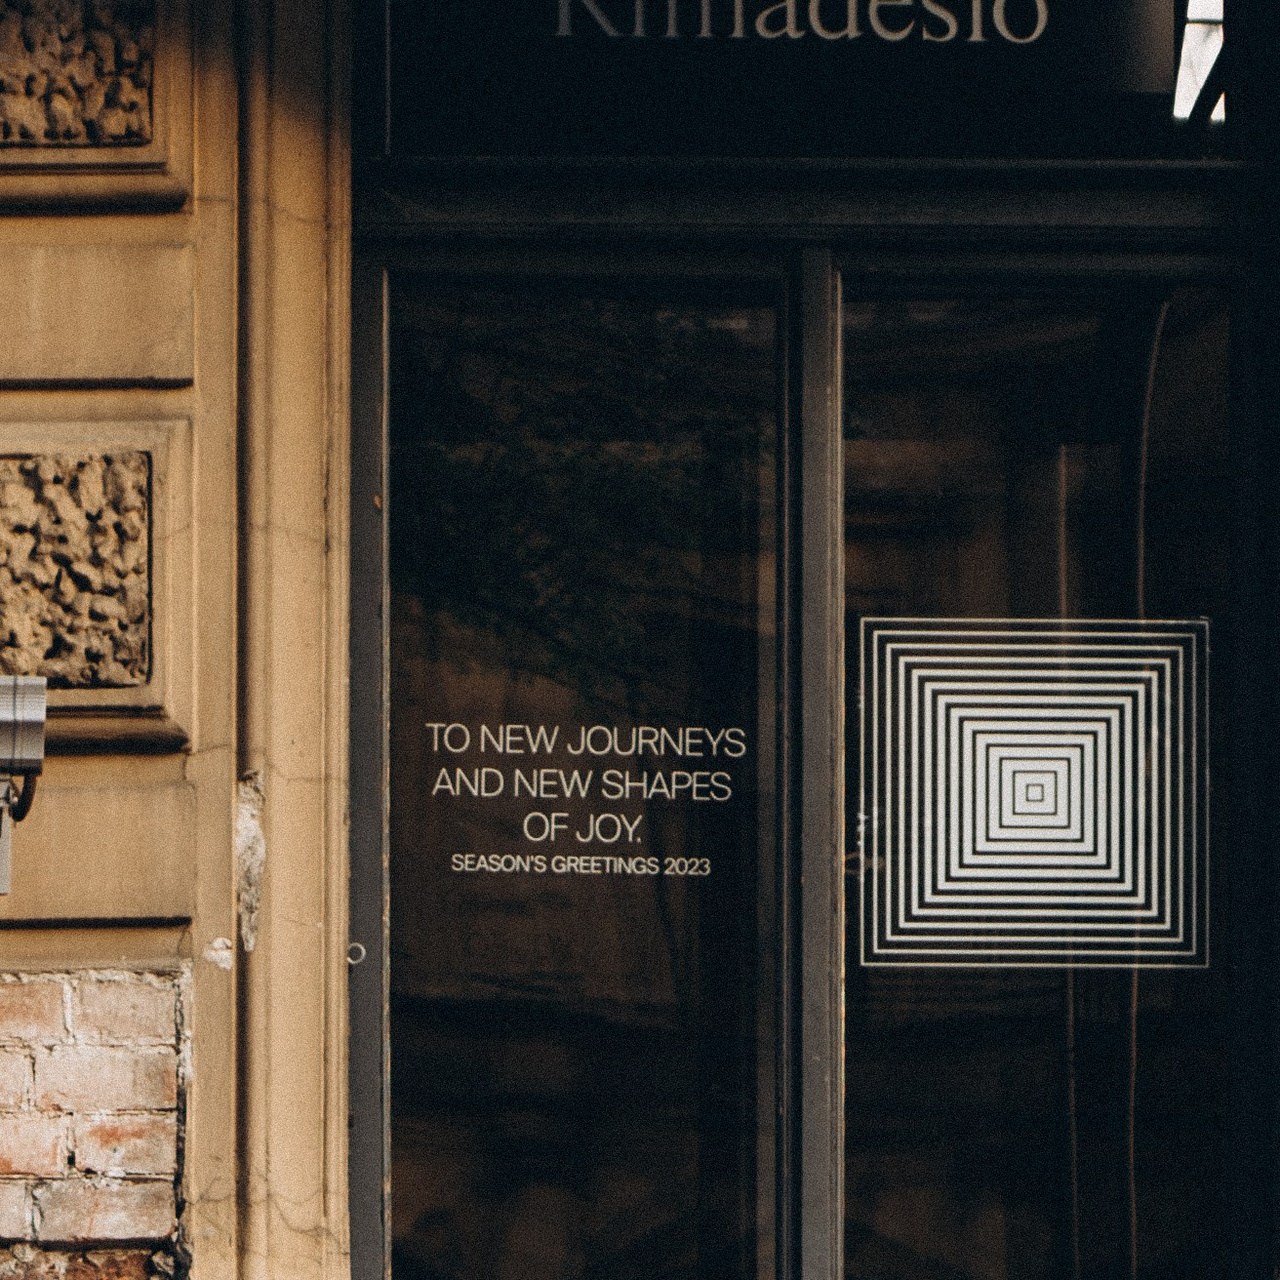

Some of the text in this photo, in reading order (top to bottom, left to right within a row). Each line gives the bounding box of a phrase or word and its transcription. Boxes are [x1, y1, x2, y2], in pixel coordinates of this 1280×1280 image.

[424, 722, 747, 758] TO NEW JOURNEYS
[431, 767, 732, 801] AND NEW SHAPES
[522, 811, 643, 844] OF JOY.
[450, 853, 711, 876] SEASON'S GREETINGS 2023
